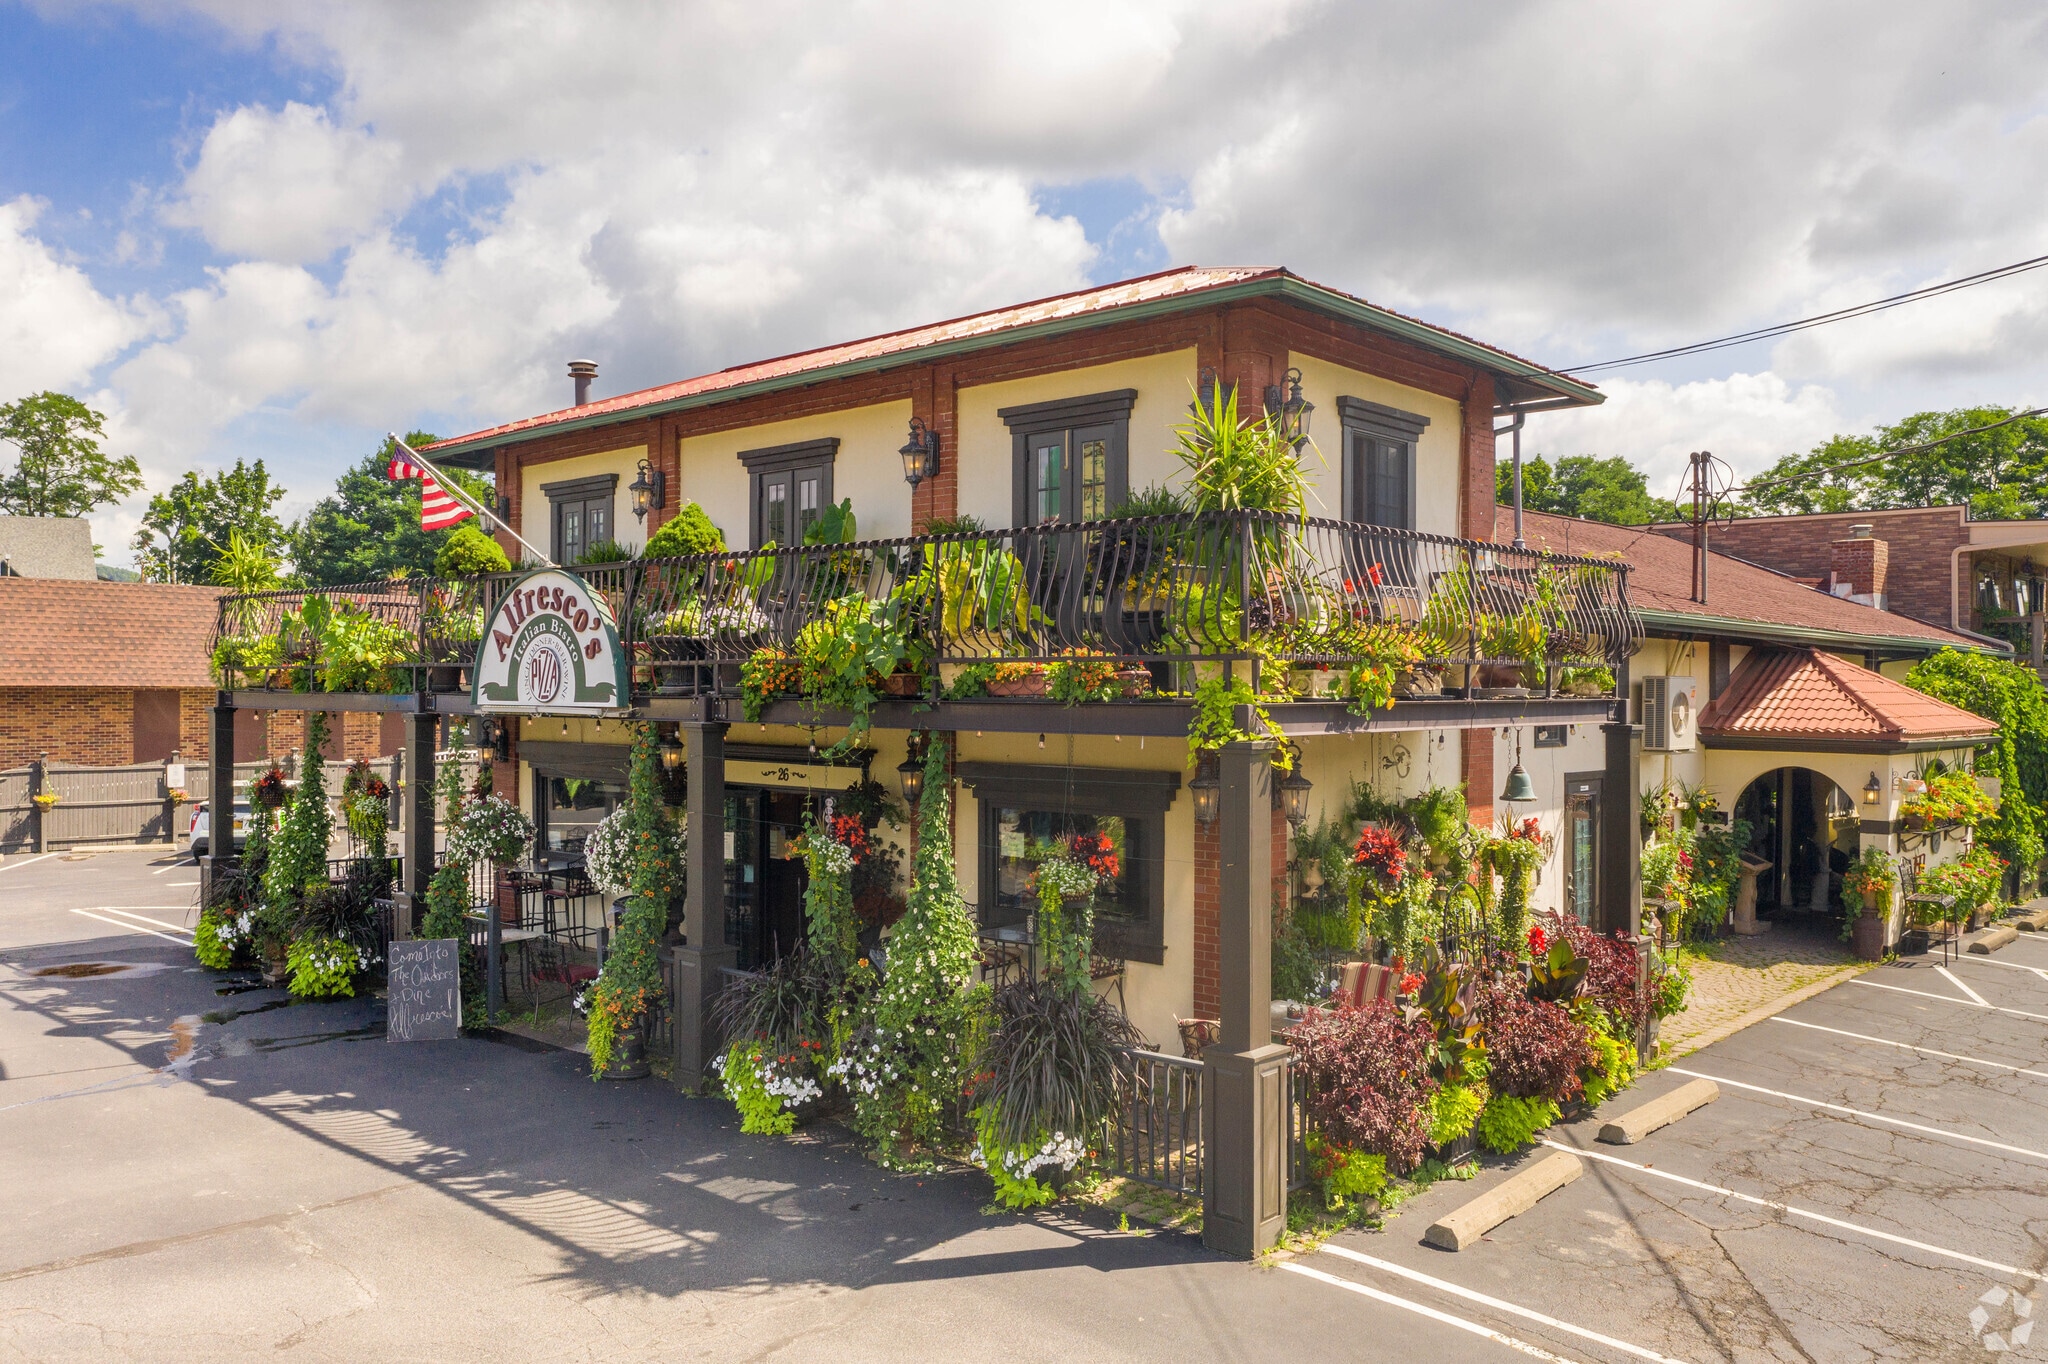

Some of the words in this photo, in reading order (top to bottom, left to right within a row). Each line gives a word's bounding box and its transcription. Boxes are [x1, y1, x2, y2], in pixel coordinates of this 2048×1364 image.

[492, 585, 602, 663] Alfresco's
[513, 622, 546, 662] Italian
[550, 618, 578, 662] Bistro
[778, 767, 789, 781] 26
[391, 965, 409, 986] The
[401, 987, 431, 1006] Dine
